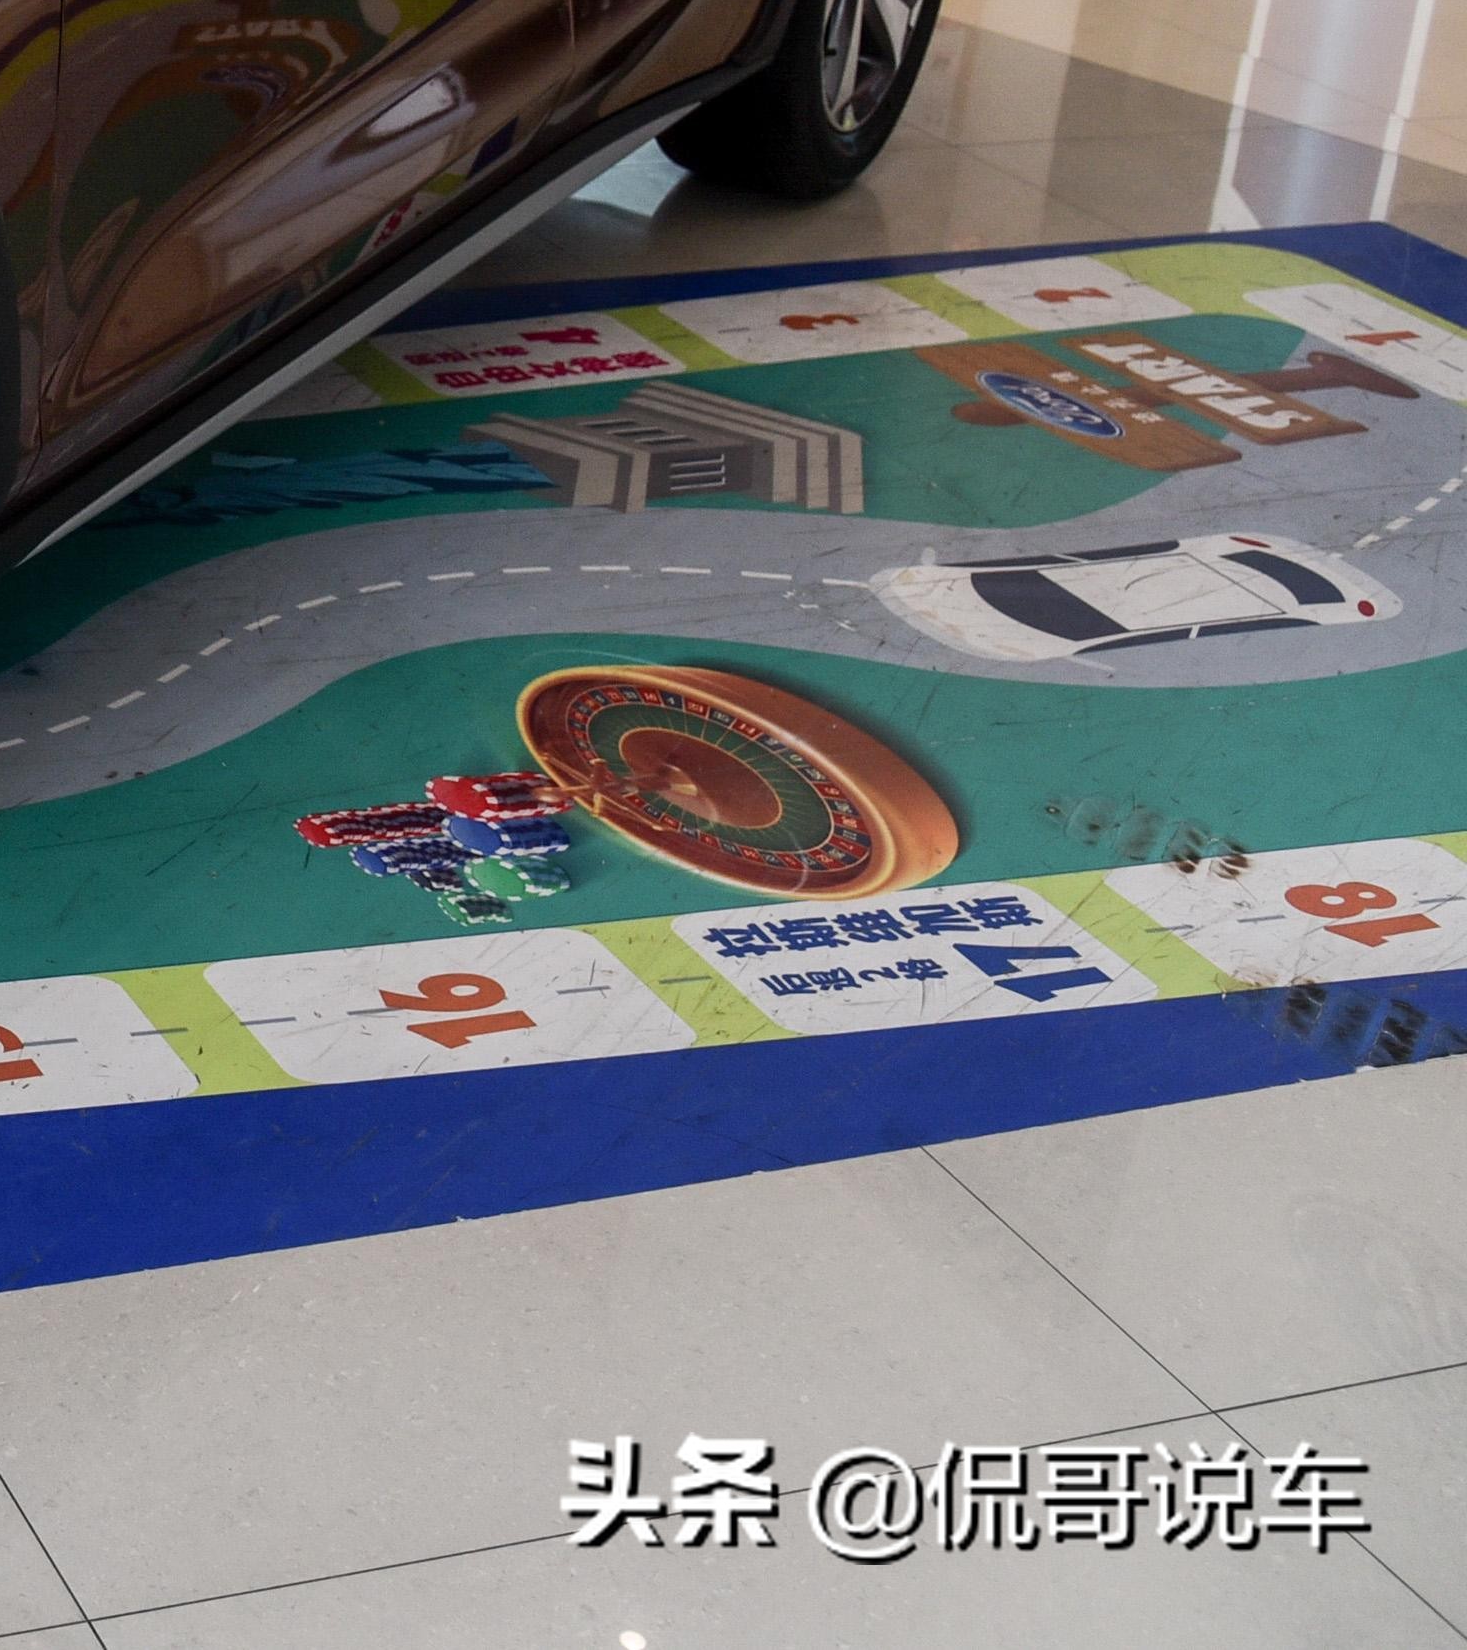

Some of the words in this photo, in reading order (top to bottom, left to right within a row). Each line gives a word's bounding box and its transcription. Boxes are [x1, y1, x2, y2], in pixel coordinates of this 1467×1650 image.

[1081, 343, 1313, 430] START
[703, 895, 1044, 959] 拉斯维加斯
[1284, 882, 1443, 948] 18
[760, 957, 949, 997] 后退2格
[953, 942, 1113, 1003] 17
[379, 973, 536, 1049] 16
